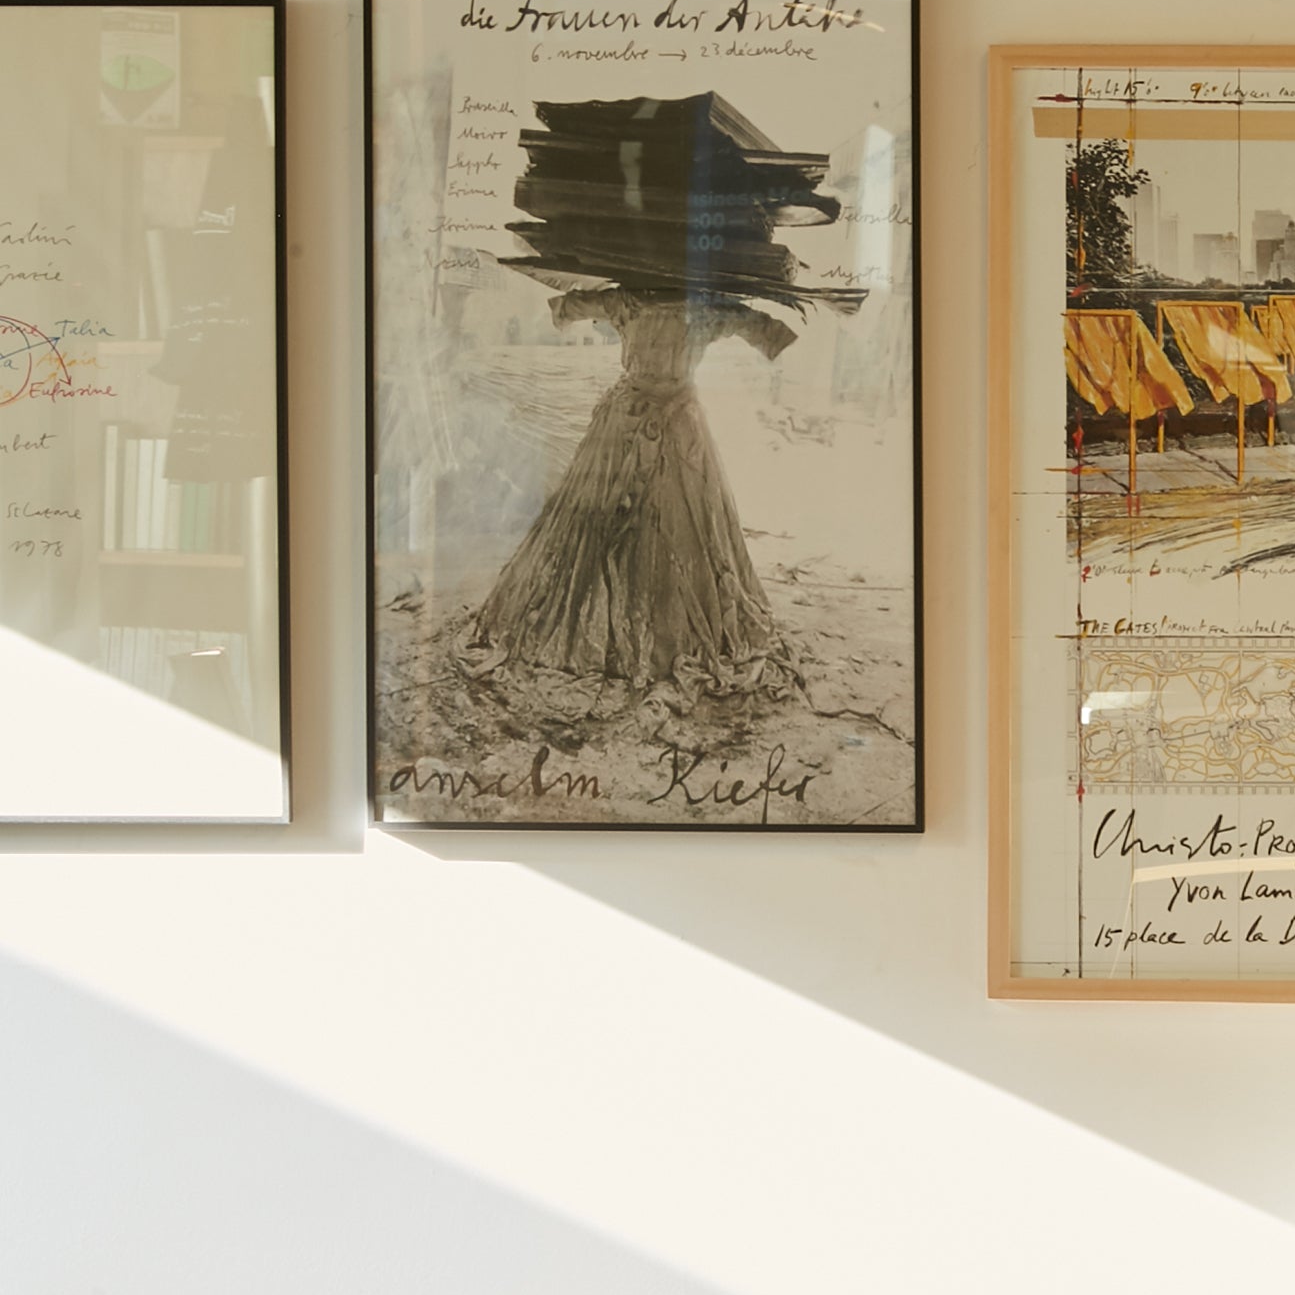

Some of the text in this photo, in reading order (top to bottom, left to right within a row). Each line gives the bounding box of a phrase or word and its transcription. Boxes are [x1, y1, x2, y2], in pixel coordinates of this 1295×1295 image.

[556, 46, 651, 63] novembre
[1167, 876, 1228, 913] Yvon
[1123, 920, 1187, 952] place
[1202, 920, 1233, 946] de
[1244, 915, 1270, 943] la
